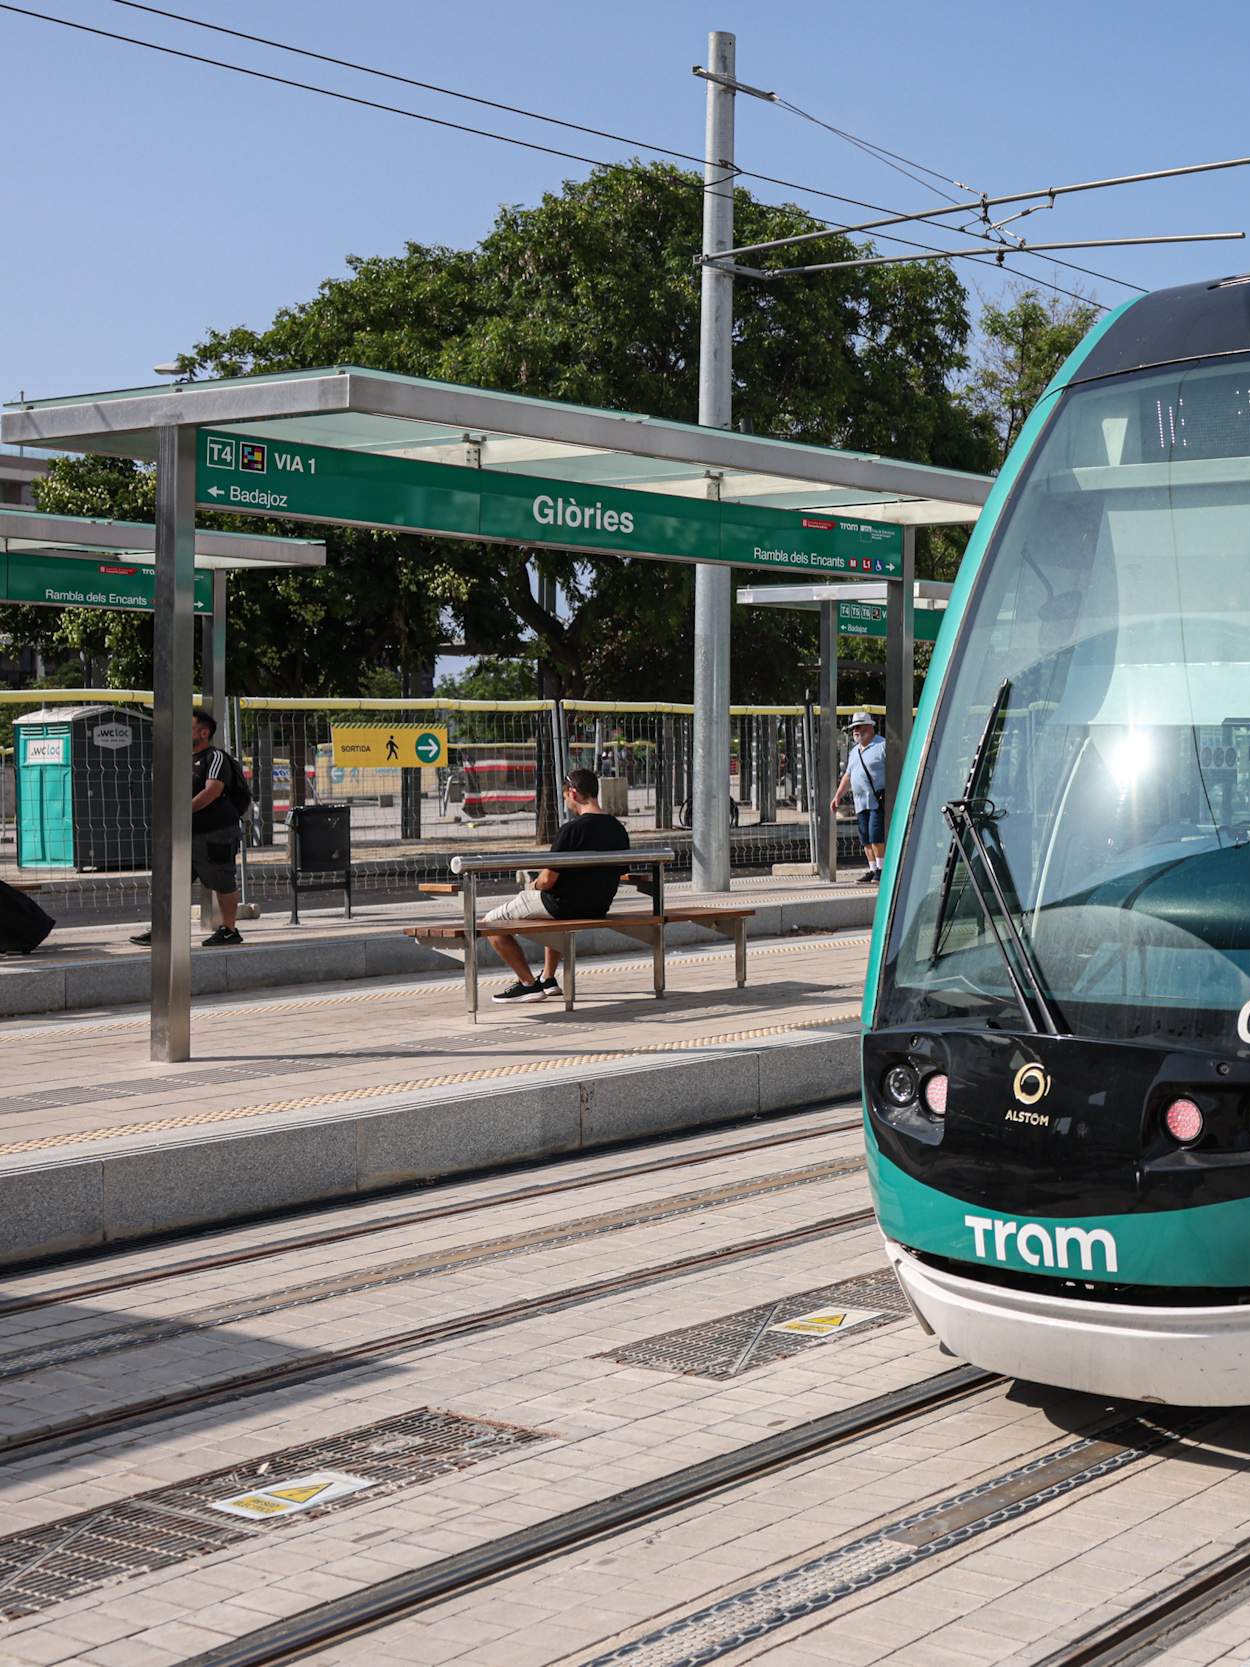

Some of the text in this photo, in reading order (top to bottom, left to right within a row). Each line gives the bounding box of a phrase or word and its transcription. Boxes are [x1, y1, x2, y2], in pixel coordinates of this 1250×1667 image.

[209, 443, 316, 474] T4 VIA 1
[230, 485, 288, 508] Badajoz
[532, 494, 634, 534] Glòries
[754, 547, 788, 562] Rambla
[790, 552, 808, 564] dels
[810, 553, 845, 568] Encants
[862, 560, 871, 568] L1
[142, 568, 156, 576] Tra
[45, 588, 148, 606] Rambla dels Encants
[1005, 1109, 1050, 1126] ALSTOM
